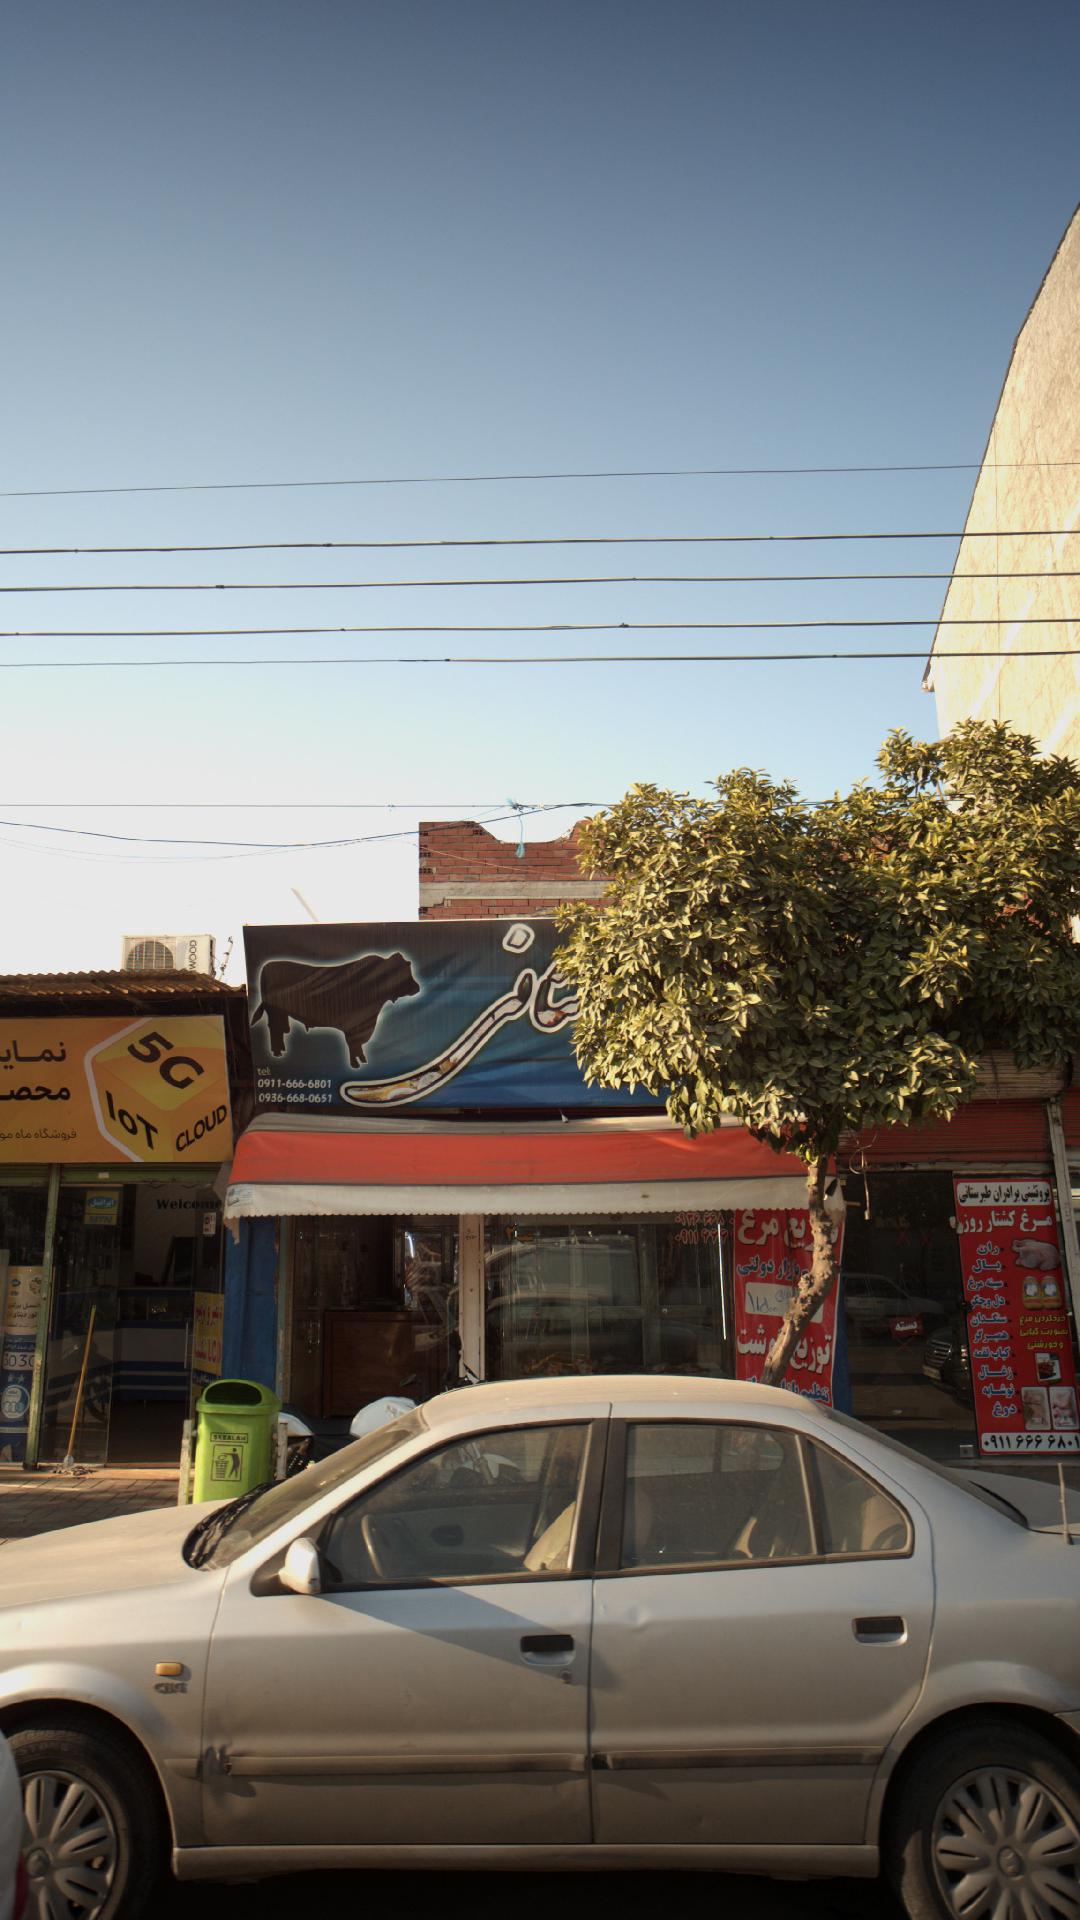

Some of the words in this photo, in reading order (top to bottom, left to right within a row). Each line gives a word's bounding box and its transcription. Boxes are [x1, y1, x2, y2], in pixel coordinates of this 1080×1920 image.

[188, 939, 197, 970] WOOD
[0, 1039, 67, 1070] نمای
[257, 1079, 332, 1089] 0911-666-6801
[0, 1086, 71, 1101] محص
[258, 1093, 333, 1103] 0936-668-0651
[33, 1127, 77, 1141] فروشگاه
[175, 1104, 228, 1152] CLOUD
[155, 1198, 222, 1210] Welcome
[986, 1210, 1015, 1232] کشتار
[1020, 1208, 1053, 1232] مرغ
[736, 1253, 775, 1277] دولتی
[984, 1434, 1012, 1449] ۰۹۱۱
[1016, 1434, 1043, 1449] ۶۶۶
[1047, 1434, 1080, 1449] ۶۸۰۱
